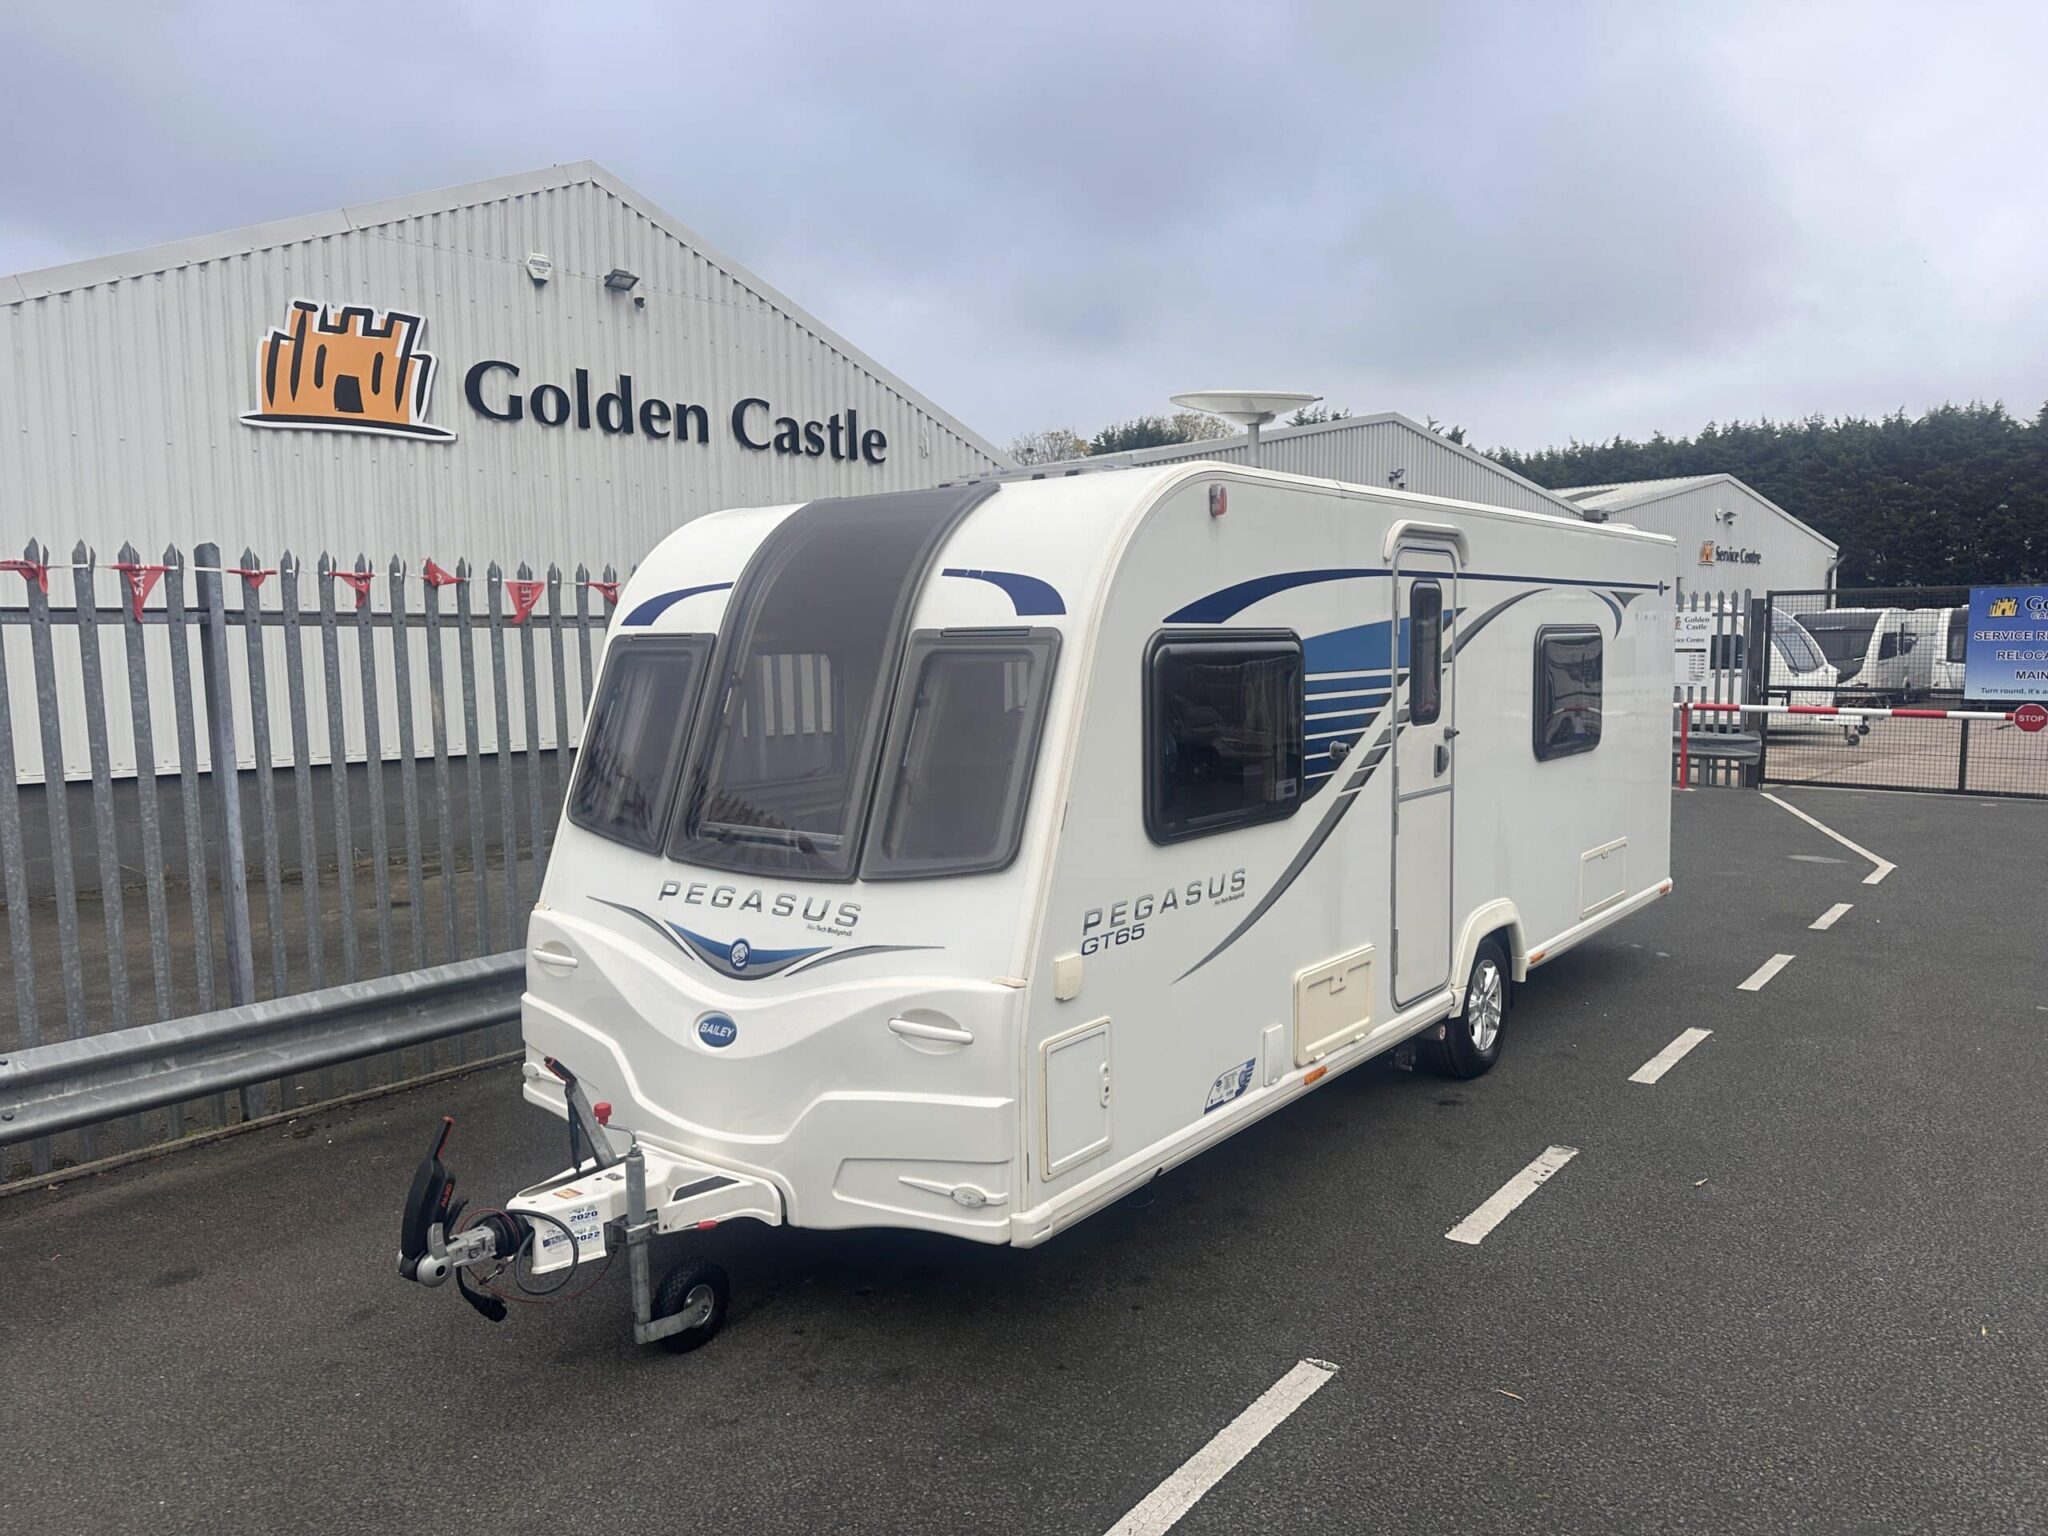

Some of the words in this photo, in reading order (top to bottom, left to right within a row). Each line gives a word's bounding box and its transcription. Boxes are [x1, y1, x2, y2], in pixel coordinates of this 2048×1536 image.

[464, 360, 710, 444] Golden
[732, 398, 888, 464] Castle
[1716, 546, 1739, 562] Service
[1740, 548, 1761, 564] Centre
[2031, 611, 2048, 620] CA
[1686, 623, 1707, 631] Castle
[1974, 630, 2033, 642] SERVICE
[2036, 631, 2048, 642] R
[2018, 714, 2045, 722] STOP
[658, 880, 862, 928] PEGASUS
[1083, 868, 1246, 936] PEGASUS
[1081, 923, 1146, 956] GT65
[700, 1022, 735, 1038] BAILEY
[570, 1210, 598, 1222] 2020
